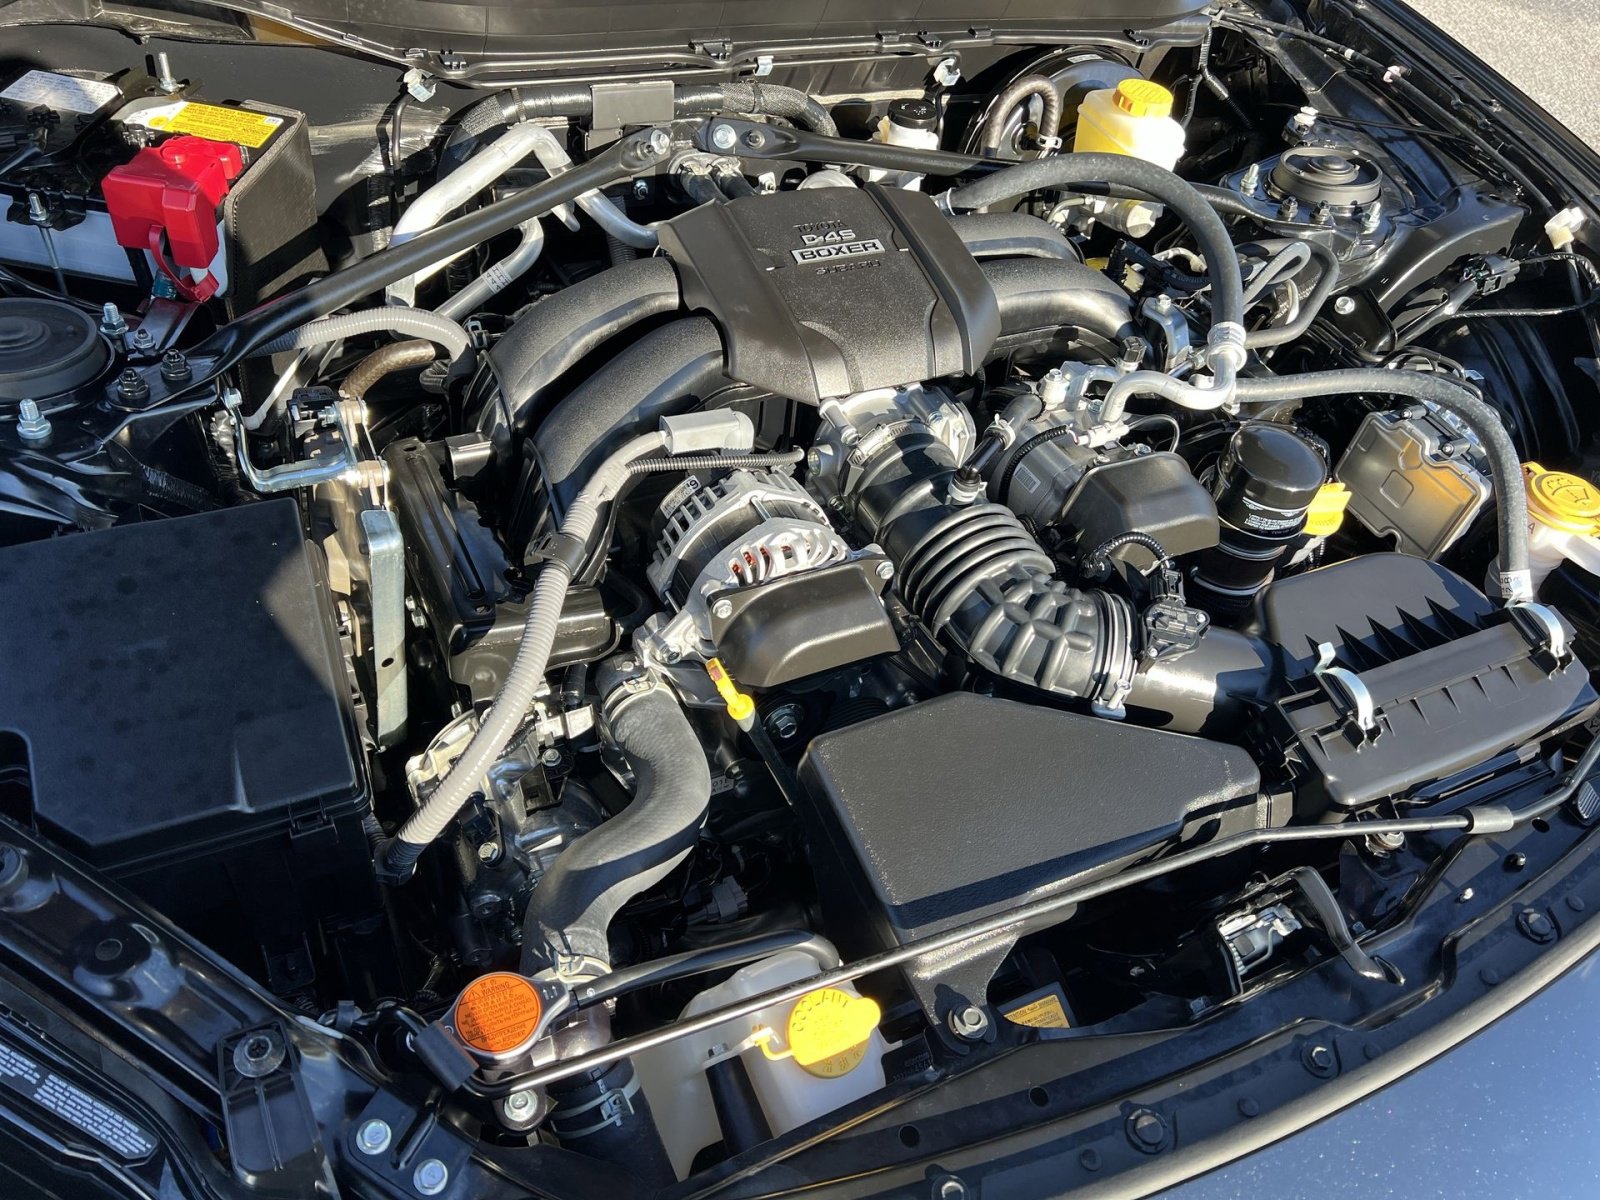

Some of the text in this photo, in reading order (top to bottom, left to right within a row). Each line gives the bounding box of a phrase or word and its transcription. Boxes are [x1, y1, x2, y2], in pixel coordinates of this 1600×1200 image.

[793, 219, 847, 233] TOYOTA
[799, 241, 880, 261] BOXER
[481, 981, 510, 996] WARNING
